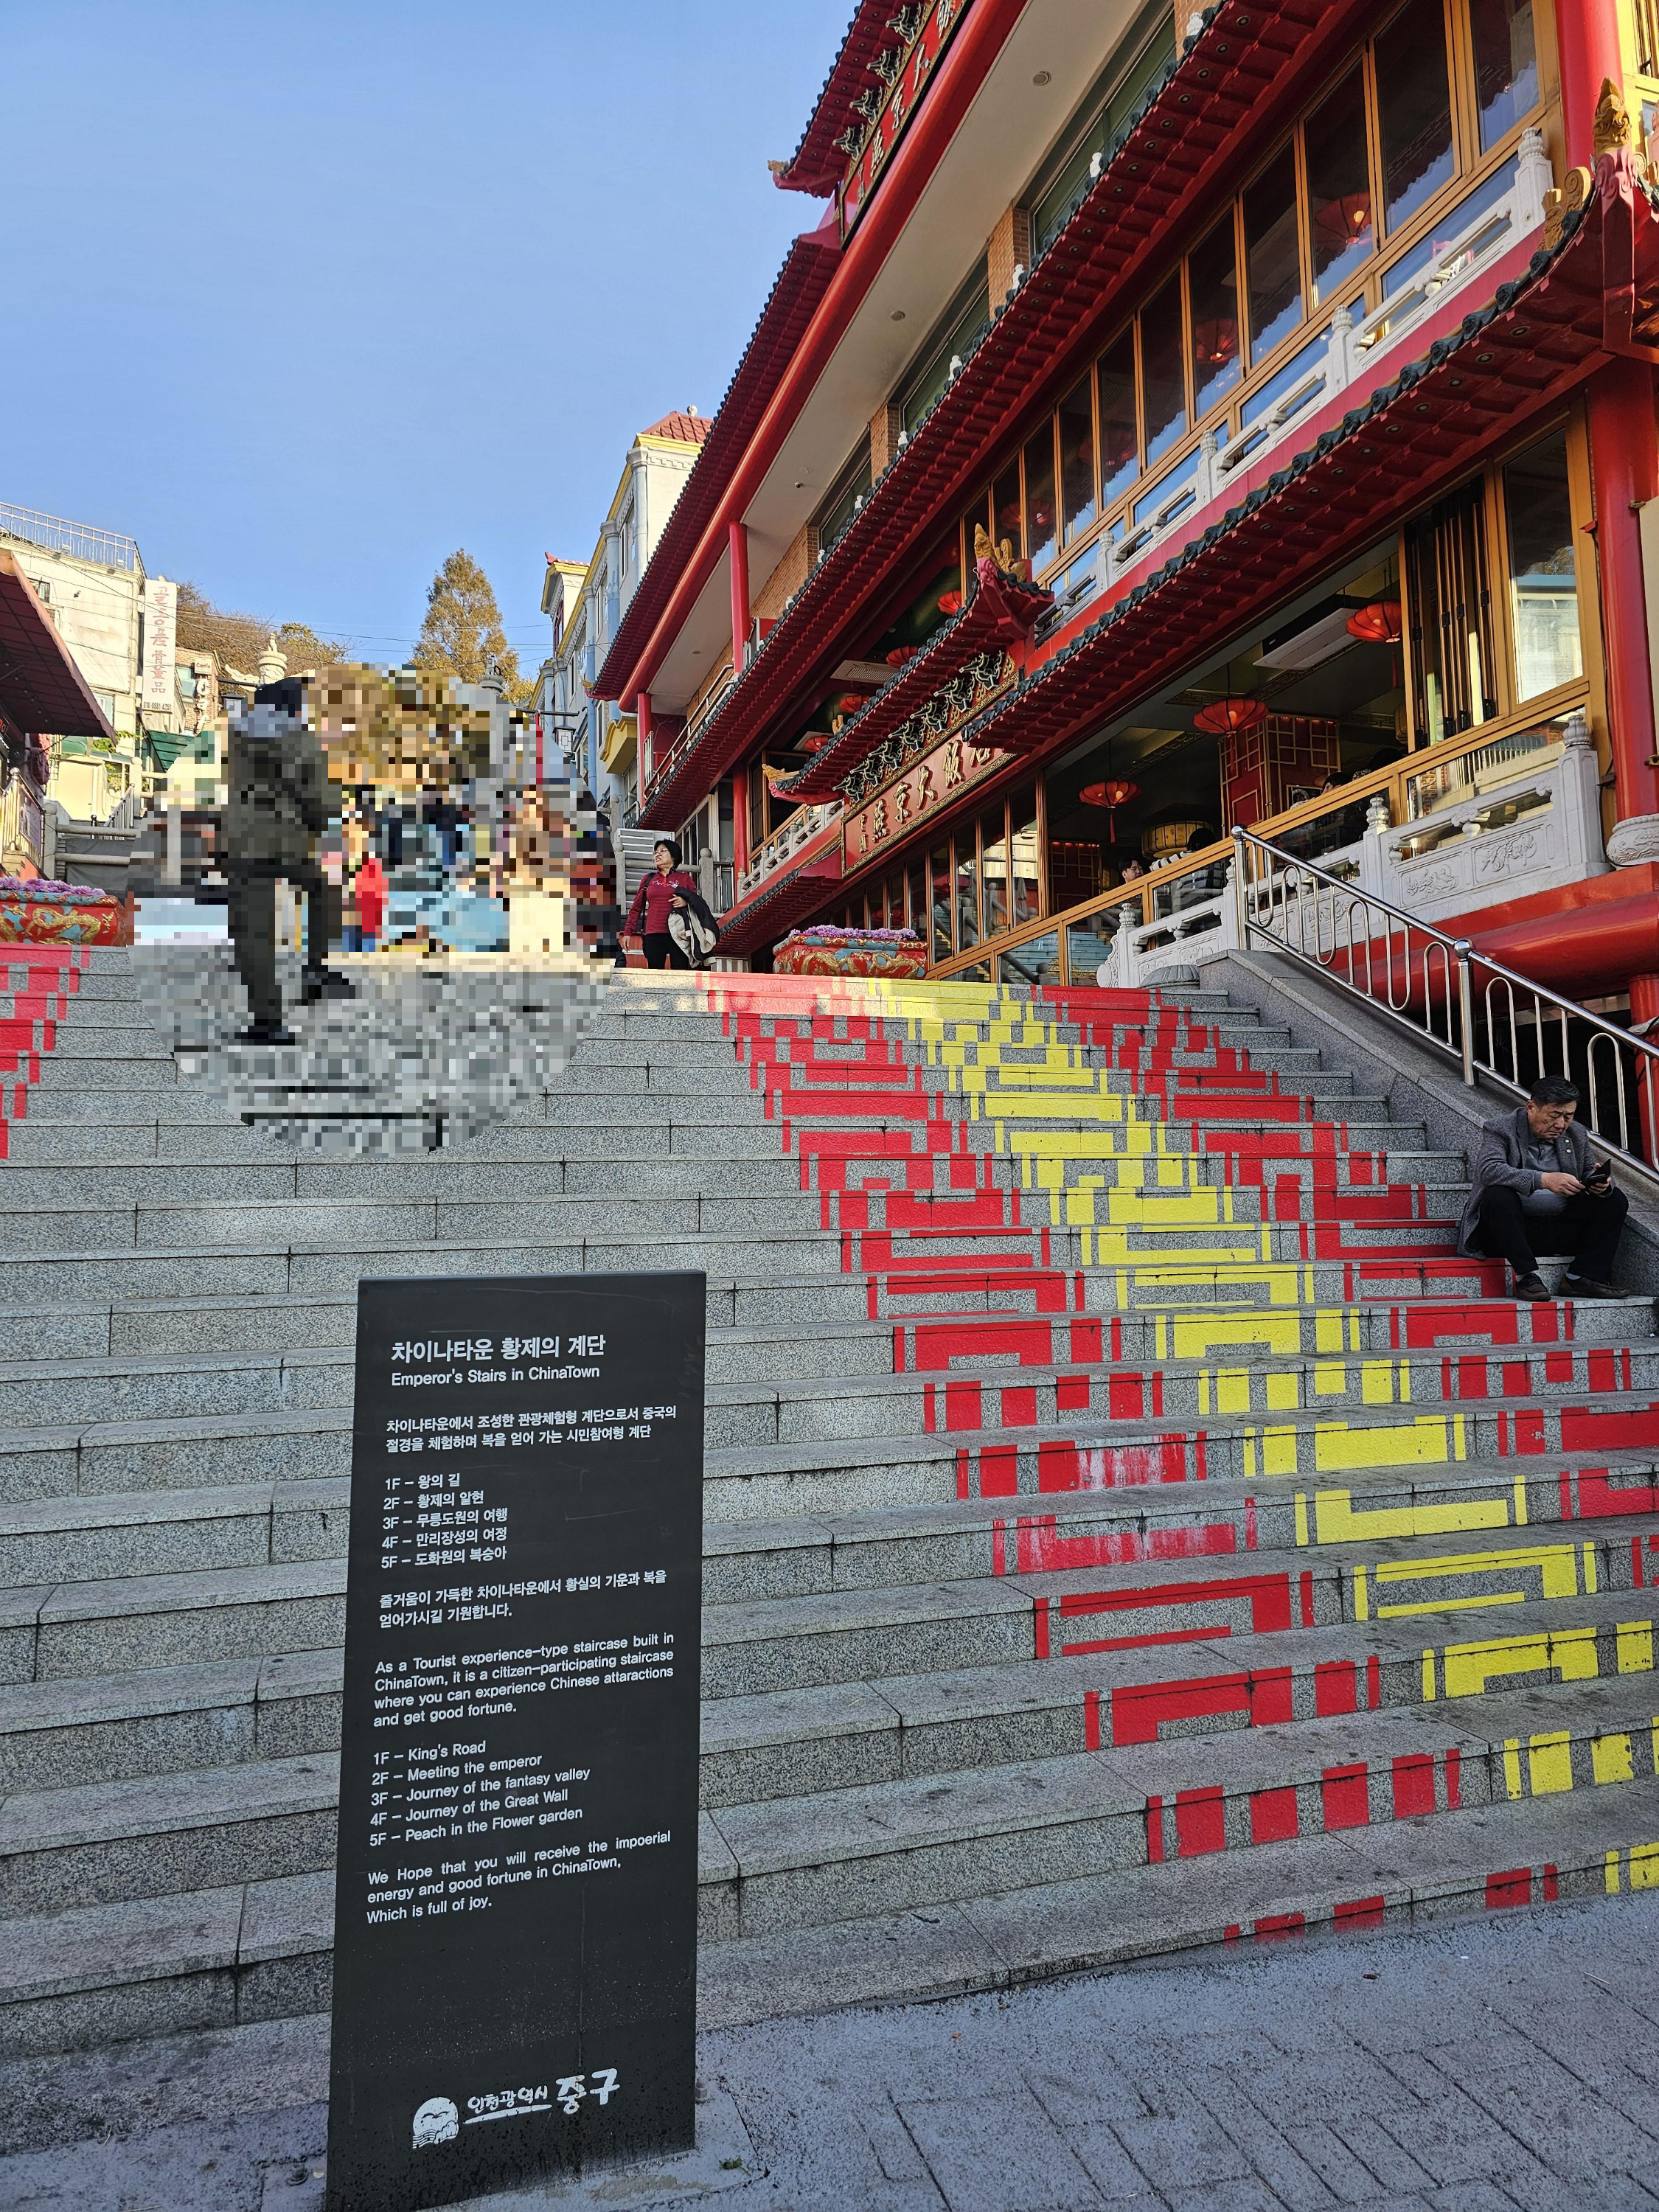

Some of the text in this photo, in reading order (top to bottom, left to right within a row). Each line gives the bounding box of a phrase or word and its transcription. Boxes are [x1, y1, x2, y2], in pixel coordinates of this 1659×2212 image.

[150, 586, 170, 646] 골동품
[151, 650, 167, 693] 骨董品
[390, 1333, 606, 1363] 차이나타운 황제의 계단
[391, 1364, 600, 1388] Emperor's Stairs in ChinaTown
[386, 1404, 676, 1433] 차이나타운에서 조성한 관광체험형 계단으로서 중국의
[385, 1424, 652, 1453] 절경을 체험하며 복을 얻어 가는 시민참여형 계단
[384, 1477, 401, 1491] 1F
[417, 1472, 443, 1489] 왕의
[447, 1472, 460, 1487] 길
[383, 1496, 400, 1510] 2F
[416, 1491, 455, 1509] 황제의
[459, 1489, 484, 1506] 알현
[381, 1515, 400, 1530] 3F
[415, 1509, 479, 1528] 무릉도원의
[482, 1506, 508, 1523] 여행
[380, 1535, 399, 1549] 4F
[415, 1528, 478, 1548] 만리장성의
[482, 1526, 507, 1542] 여정
[380, 1554, 398, 1569] 5F
[414, 1548, 465, 1566] 도화원의
[468, 1545, 507, 1562] 복숭아
[378, 1568, 667, 1609] 즐거움이 가득한 차이나타운에서 황실의 기운과 복을
[378, 1601, 512, 1629] 얻어가시길 기원합니다.
[374, 1660, 393, 1674] As
[397, 1660, 407, 1672] a
[411, 1653, 456, 1670] Tourist
[572, 1638, 628, 1654] staircase
[633, 1632, 658, 1647] built
[663, 1631, 674, 1644] in
[374, 1674, 448, 1691] ChinaTown,
[452, 1670, 461, 1683] it
[464, 1669, 476, 1683] is
[479, 1669, 488, 1680] a
[619, 1650, 674, 1666] staircase
[373, 1666, 674, 1709] where you can experience Chinese attaractions
[372, 1701, 517, 1728] and get good fortune.
[372, 1750, 390, 1765] 1F
[408, 1742, 448, 1761] King's
[451, 1739, 486, 1756] Road
[371, 1770, 389, 1786] 2F
[407, 1764, 459, 1781] Meeting
[463, 1761, 485, 1774] the
[488, 1754, 543, 1771] emperor
[370, 1791, 389, 1806] 3F
[406, 1785, 459, 1801] Journey
[462, 1780, 476, 1794] of
[479, 1778, 501, 1792] the
[504, 1773, 551, 1789] fantasy
[554, 1767, 591, 1782] valley
[369, 1811, 388, 1826] 4F
[405, 1805, 459, 1822] Journey
[462, 1799, 476, 1814] of
[479, 1798, 501, 1812] the
[504, 1792, 539, 1809] Great
[542, 1787, 568, 1804] Wall
[369, 1832, 387, 1846] 5F
[405, 1824, 446, 1842] Peach
[450, 1822, 463, 1836] in
[466, 1820, 488, 1833] the
[491, 1814, 535, 1830] Flower
[538, 1807, 582, 1826] garden
[367, 1829, 671, 1885] We Hope that you will receive the impoerial
[366, 1857, 621, 1903] energy and good fortune in ChinaTown,
[366, 1895, 492, 1924] Which is full of joy.
[467, 2067, 621, 2115] 인천광역시 중구
